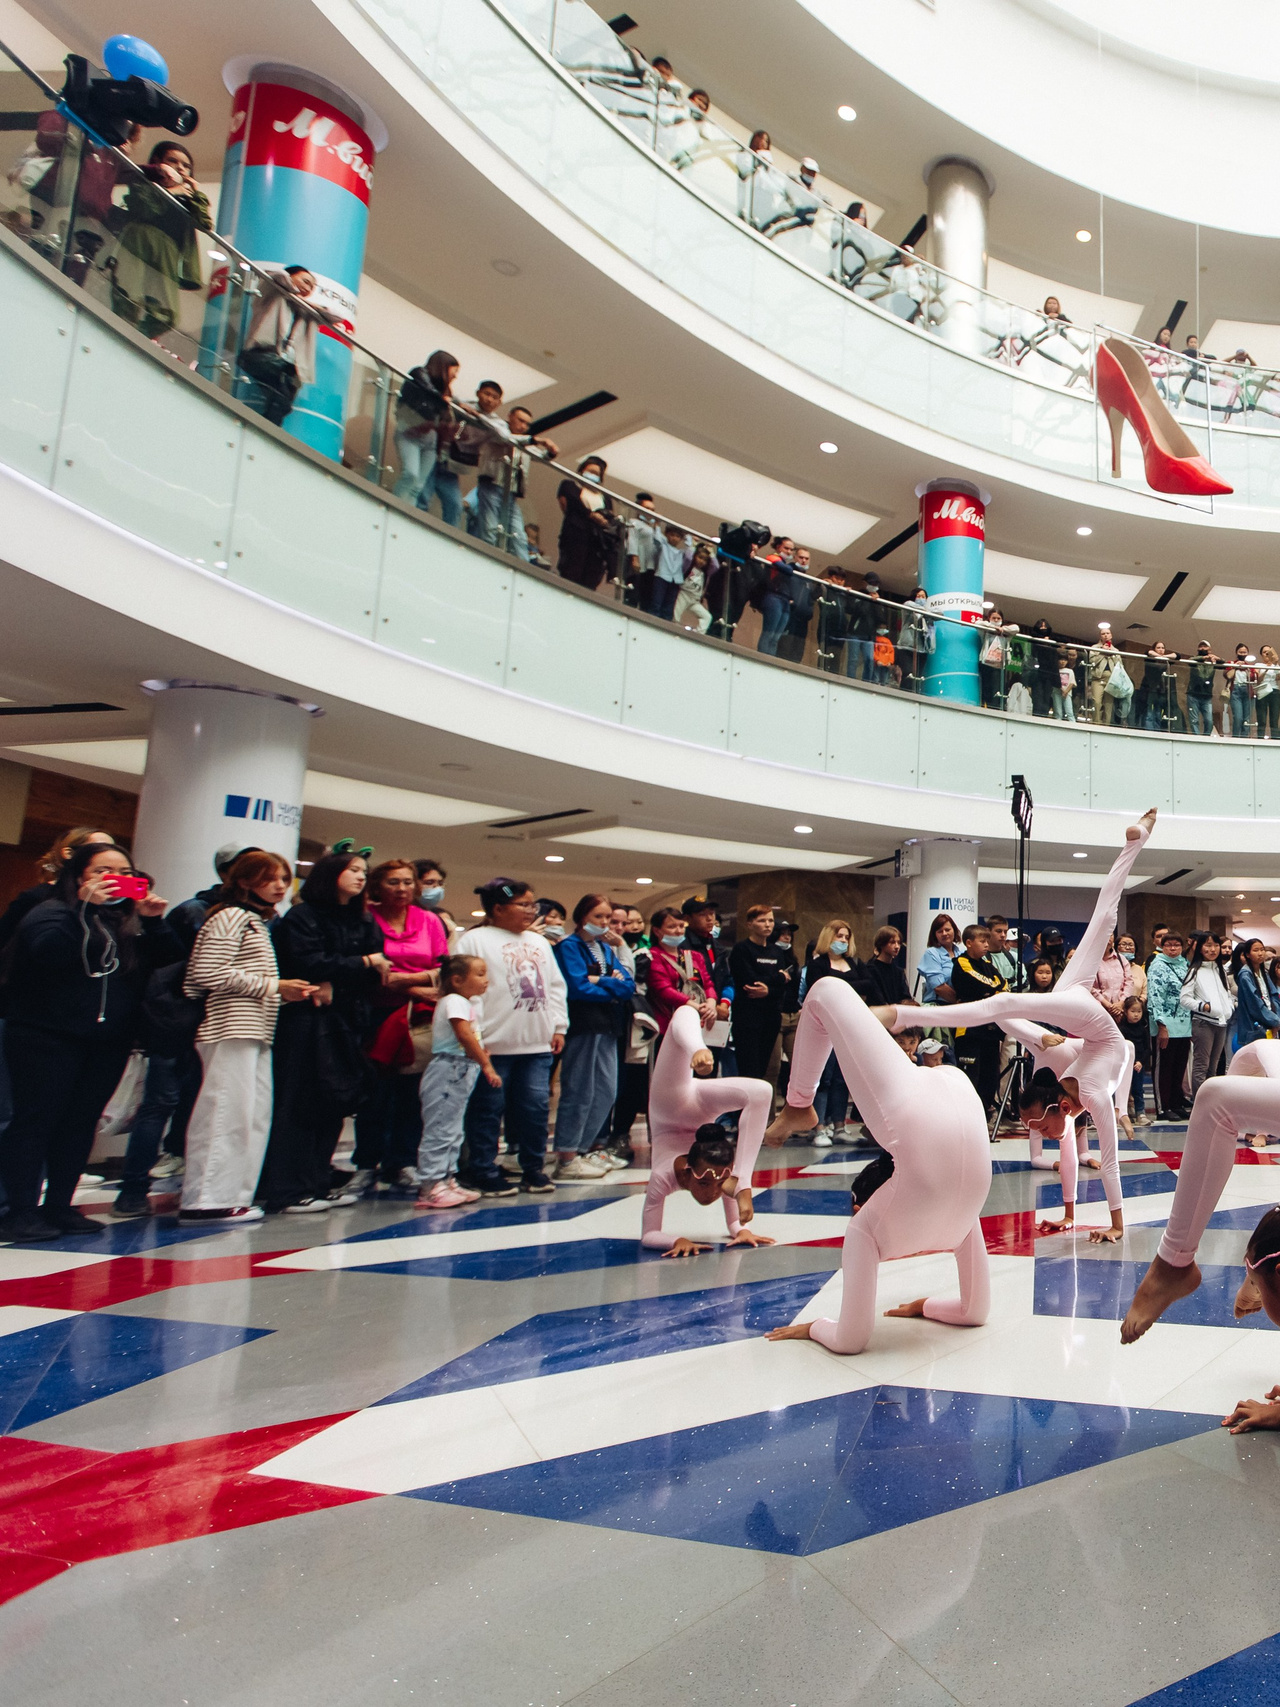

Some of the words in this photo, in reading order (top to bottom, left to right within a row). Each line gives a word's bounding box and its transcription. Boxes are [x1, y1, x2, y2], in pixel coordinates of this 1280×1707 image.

[933, 499, 986, 532] М.вид
[954, 898, 974, 906] ЧИТАЙ
[954, 904, 974, 913] ГОРОД
